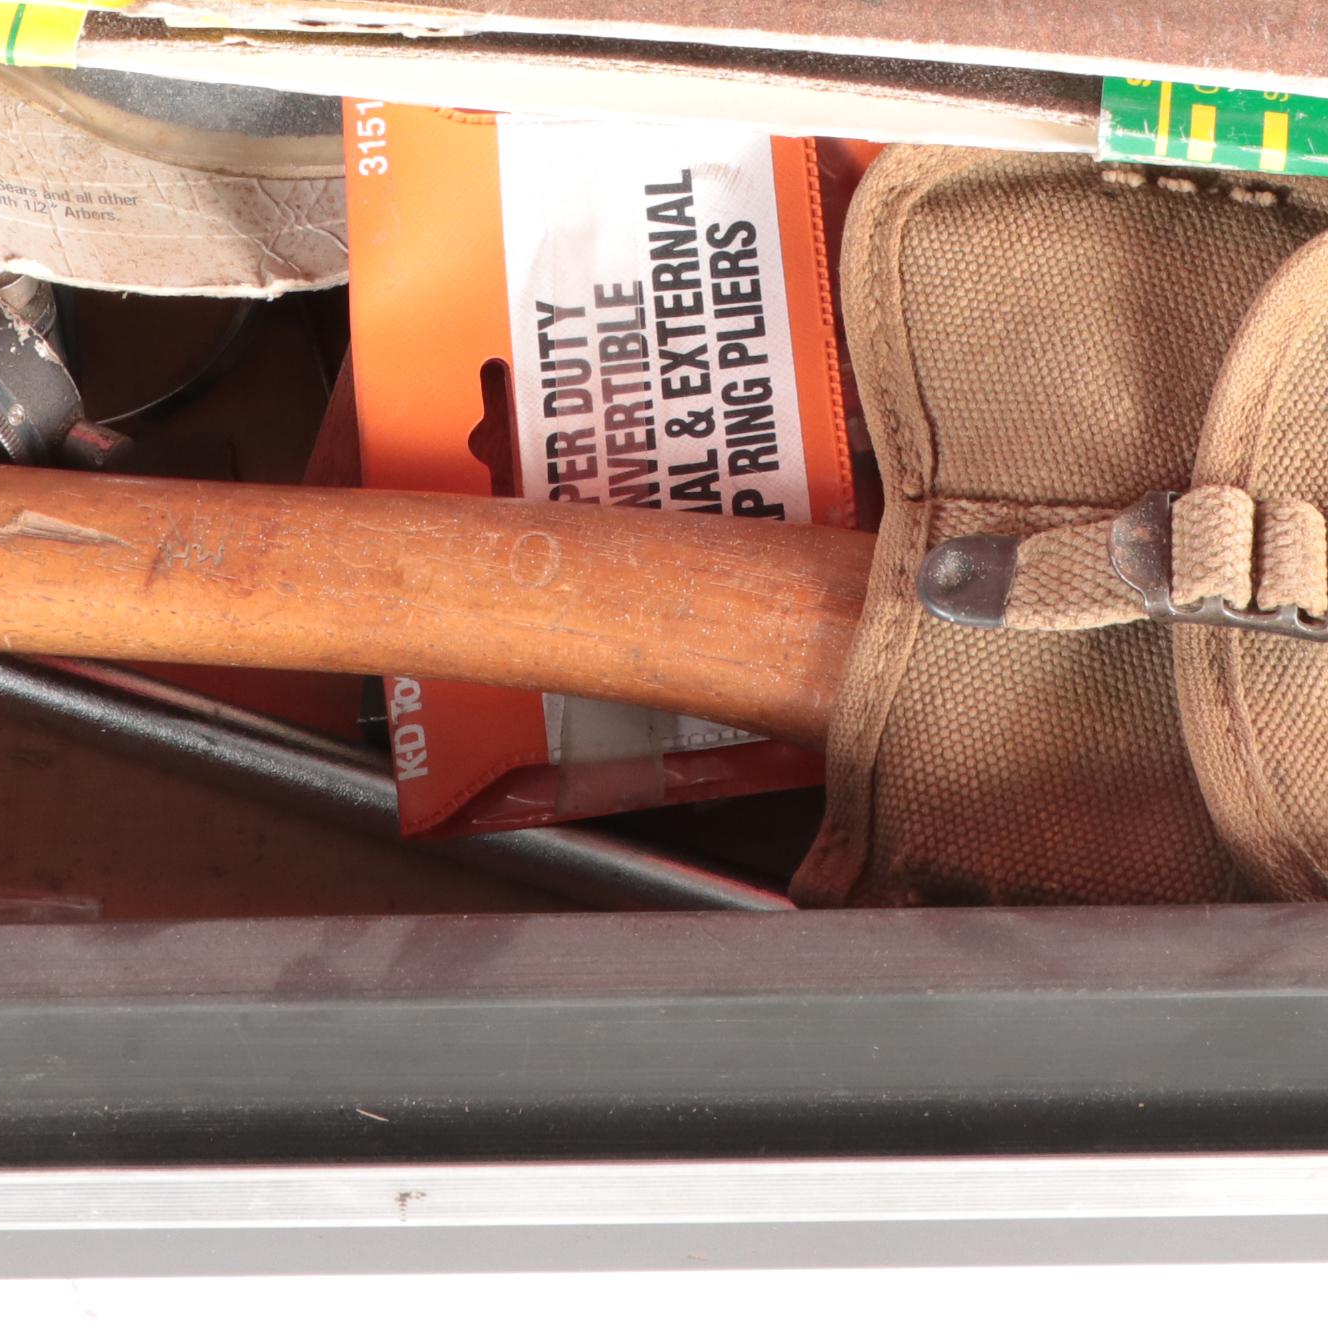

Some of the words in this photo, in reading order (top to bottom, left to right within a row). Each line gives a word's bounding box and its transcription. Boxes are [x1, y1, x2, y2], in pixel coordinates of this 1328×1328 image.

[357, 99, 388, 175] 3151
[43, 190, 71, 203] and
[76, 192, 93, 205] all
[98, 191, 139, 207] other
[644, 168, 712, 400] EXTERNAL
[706, 219, 768, 370] PLIERS
[535, 299, 594, 419] DUTY
[664, 405, 716, 440] &
[718, 376, 779, 476] RING
